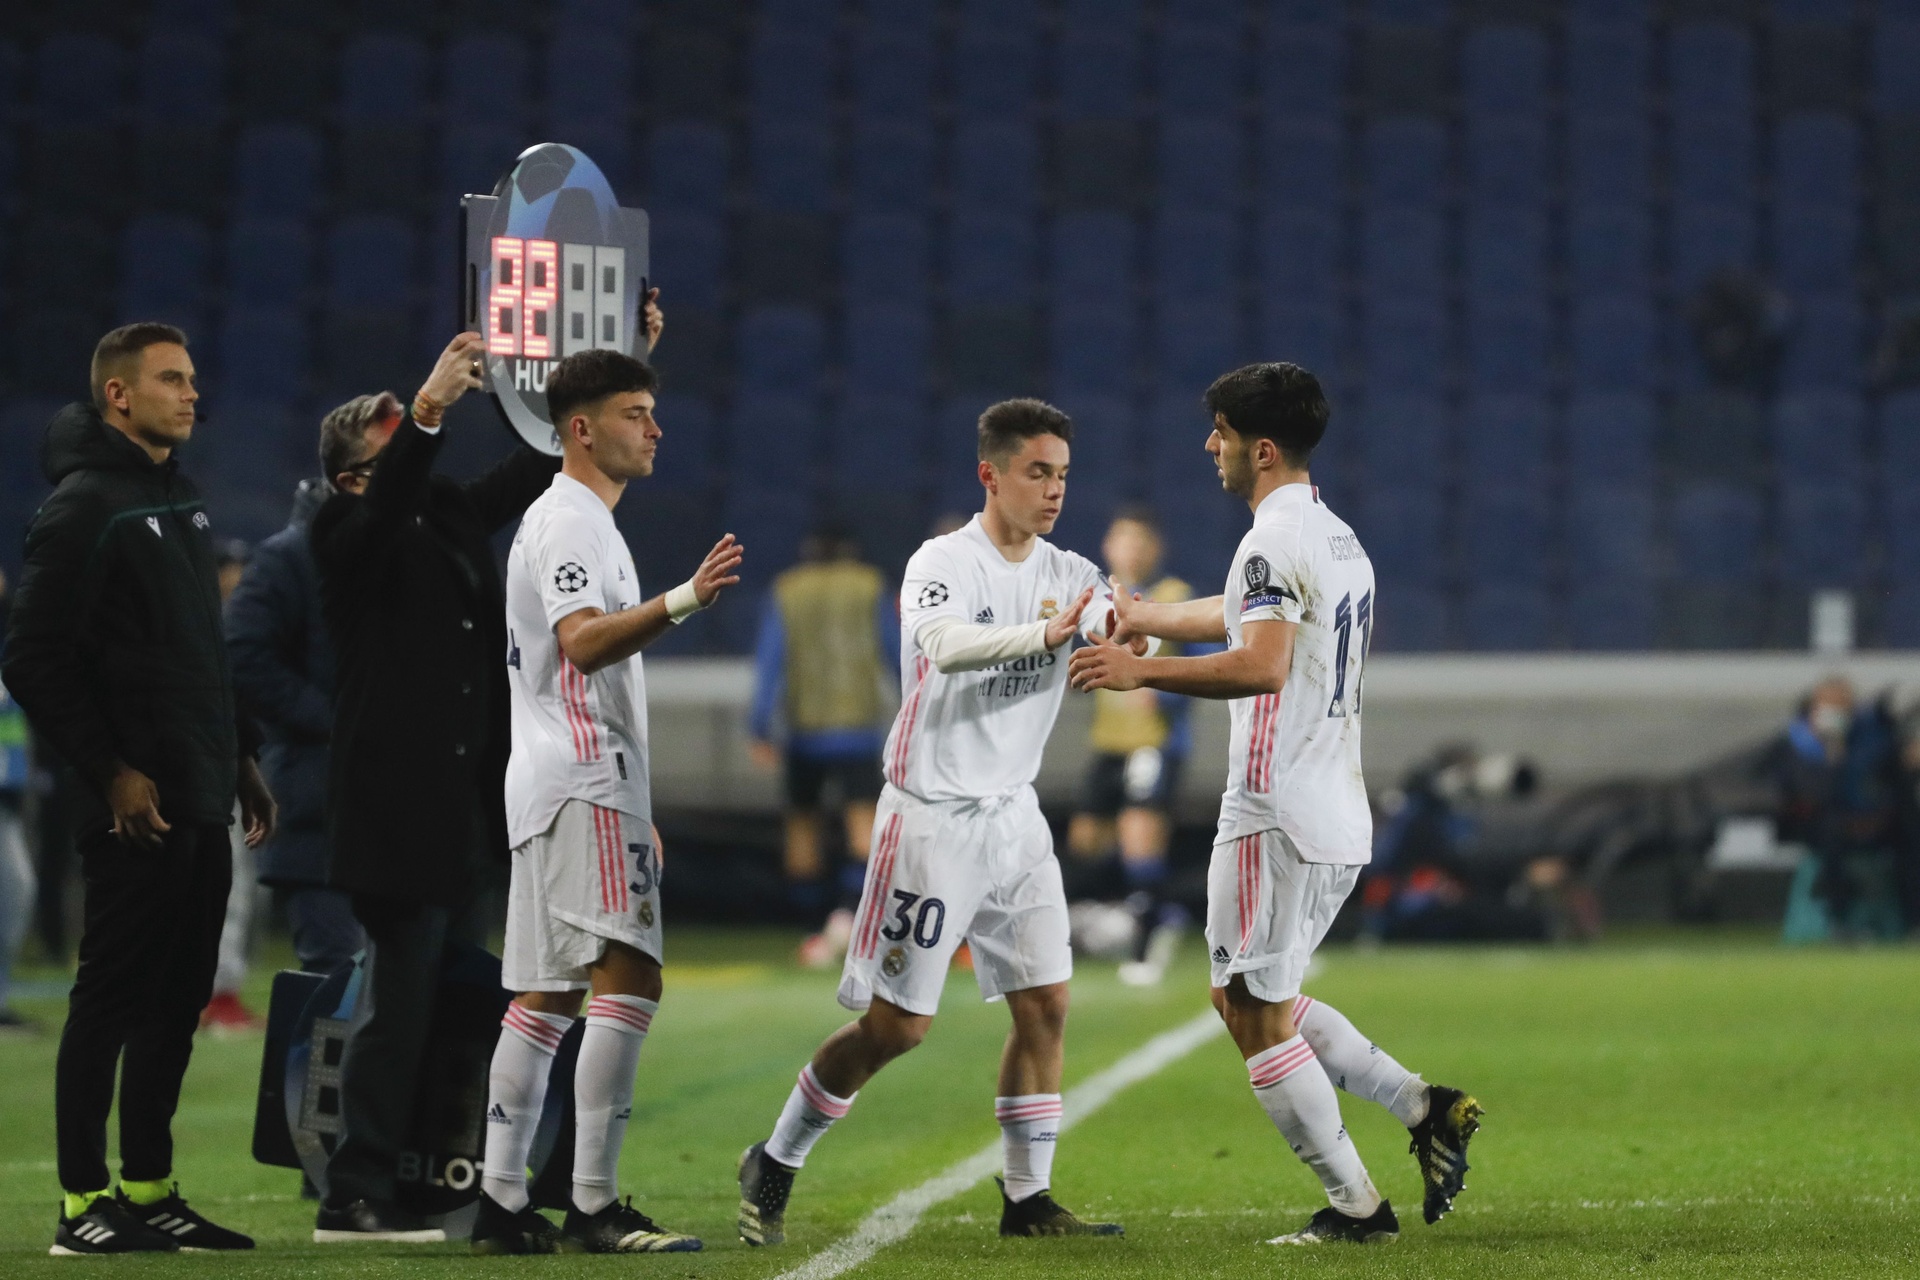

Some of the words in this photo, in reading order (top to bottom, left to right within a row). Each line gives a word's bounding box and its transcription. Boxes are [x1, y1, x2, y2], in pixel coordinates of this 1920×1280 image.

[490, 237, 557, 357] 22
[1248, 595, 1281, 606] RESPECT
[1252, 572, 1262, 584] 13
[1328, 587, 1371, 718] 11
[881, 888, 945, 949] 30
